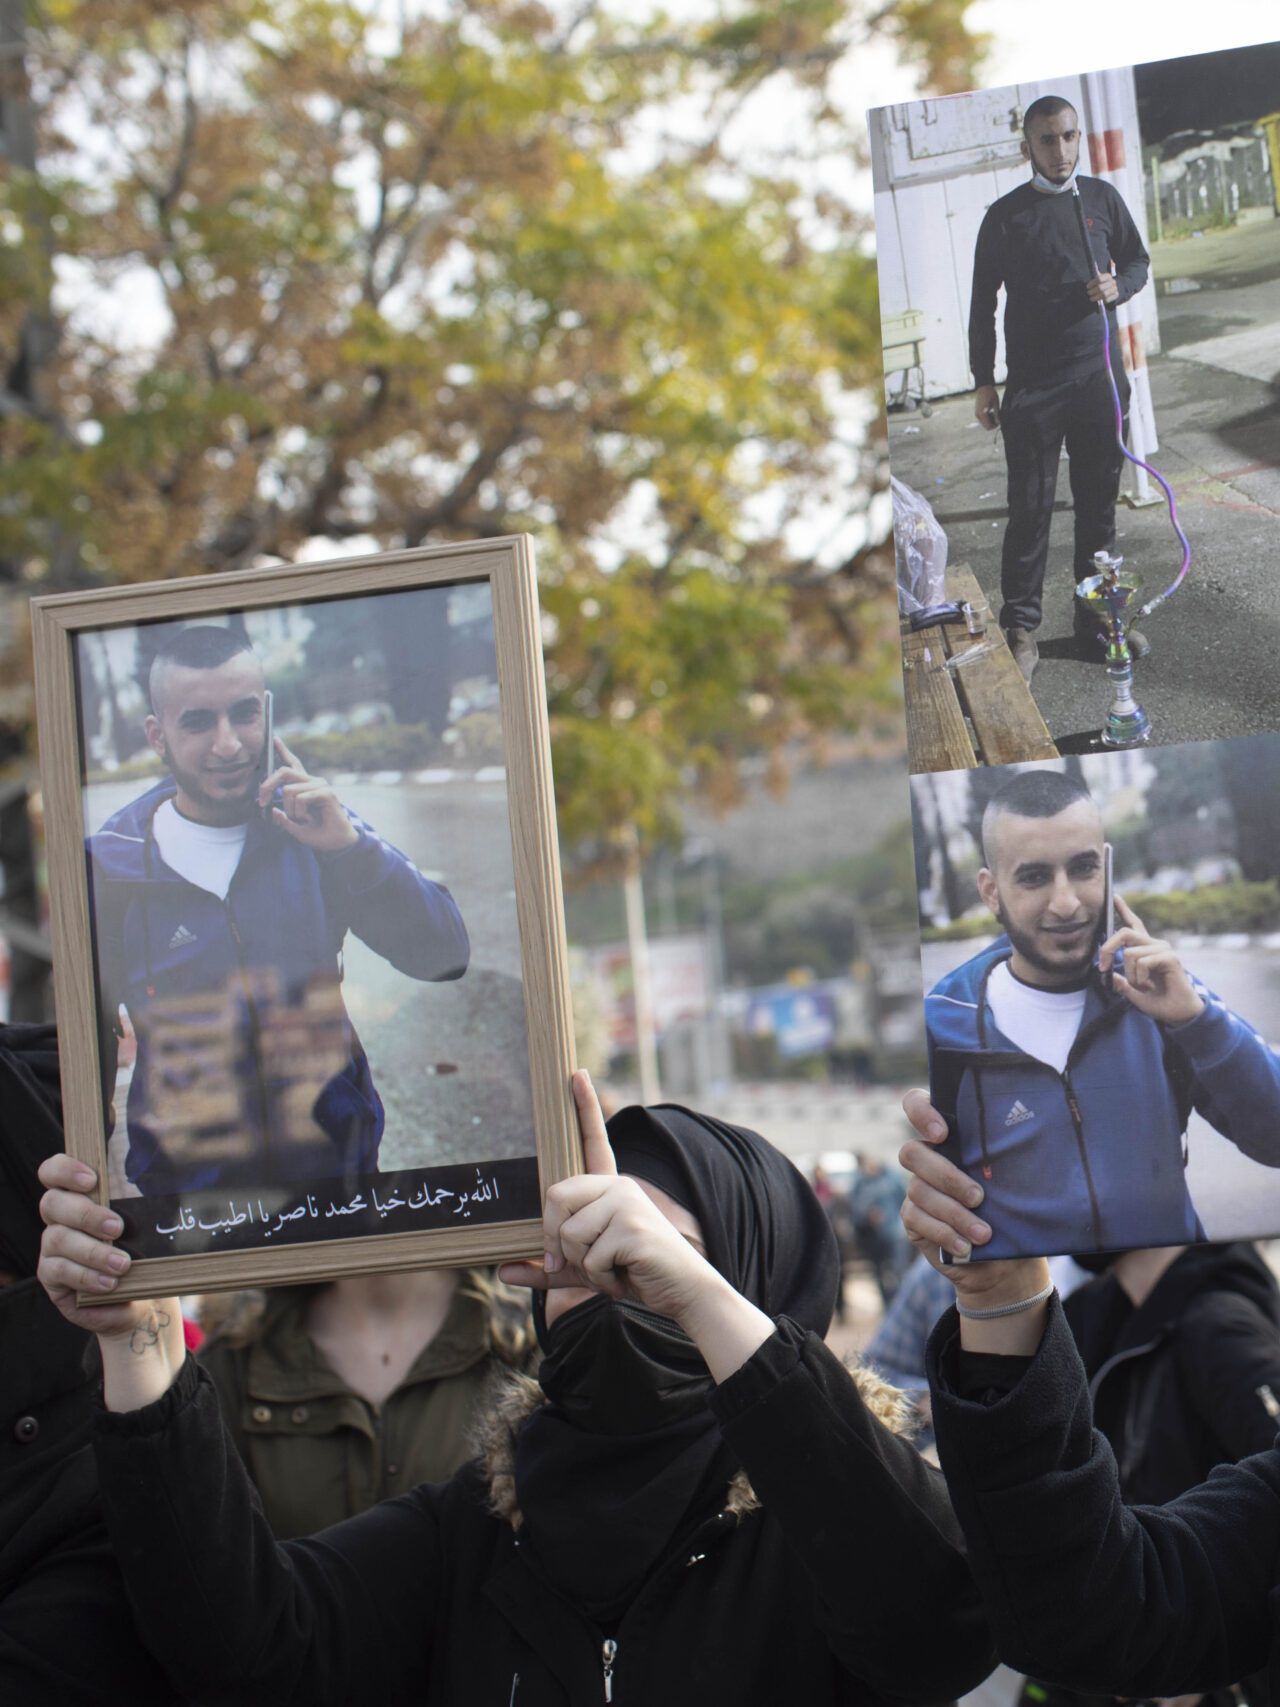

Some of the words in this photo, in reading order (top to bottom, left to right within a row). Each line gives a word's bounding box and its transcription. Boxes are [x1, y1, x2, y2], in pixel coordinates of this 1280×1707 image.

[408, 1182, 469, 1217] يرحمك
[471, 1168, 500, 1202] الله
[198, 1200, 254, 1236] اطيب
[257, 1199, 272, 1237] يا
[273, 1194, 319, 1231] ناصر
[325, 1194, 367, 1218] محمد
[372, 1187, 406, 1218] خيا
[155, 1207, 196, 1240] قلب
